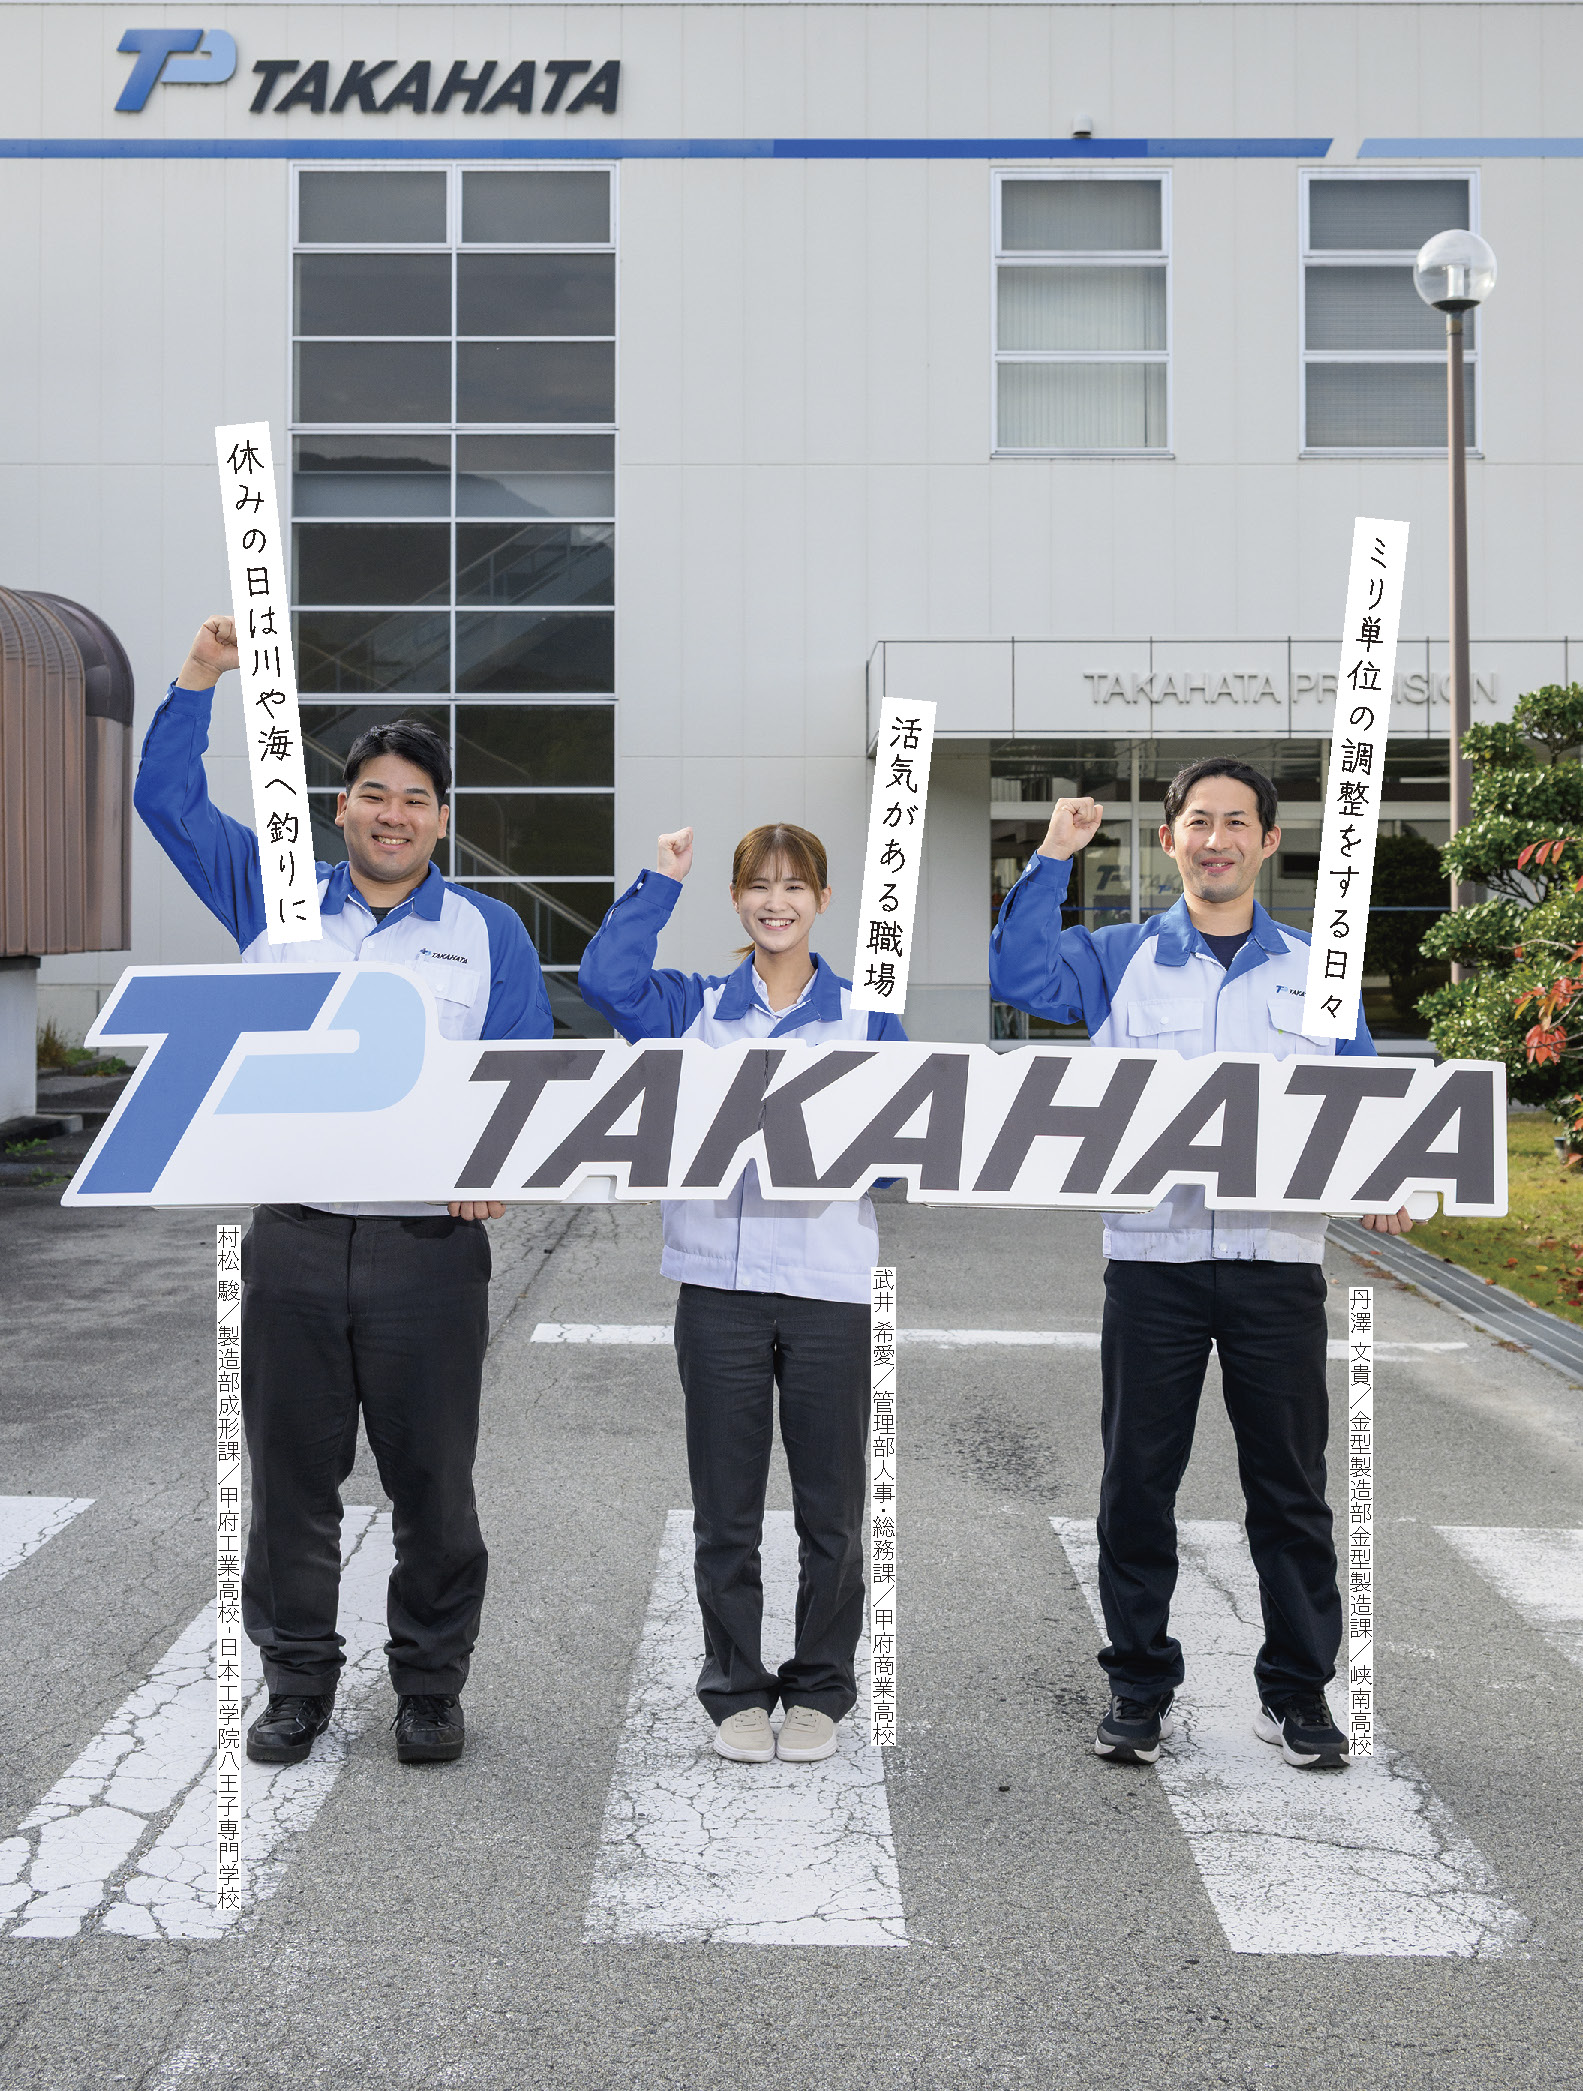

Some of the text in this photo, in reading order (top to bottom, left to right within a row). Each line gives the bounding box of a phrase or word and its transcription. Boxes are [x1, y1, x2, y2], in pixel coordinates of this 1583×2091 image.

[249, 60, 621, 113] TAKAHATA
[1083, 671, 1498, 704] TAKAHATA PRISIN
[432, 952, 468, 964] TAKAHATA
[453, 1049, 1495, 1205] TAKAHATA
